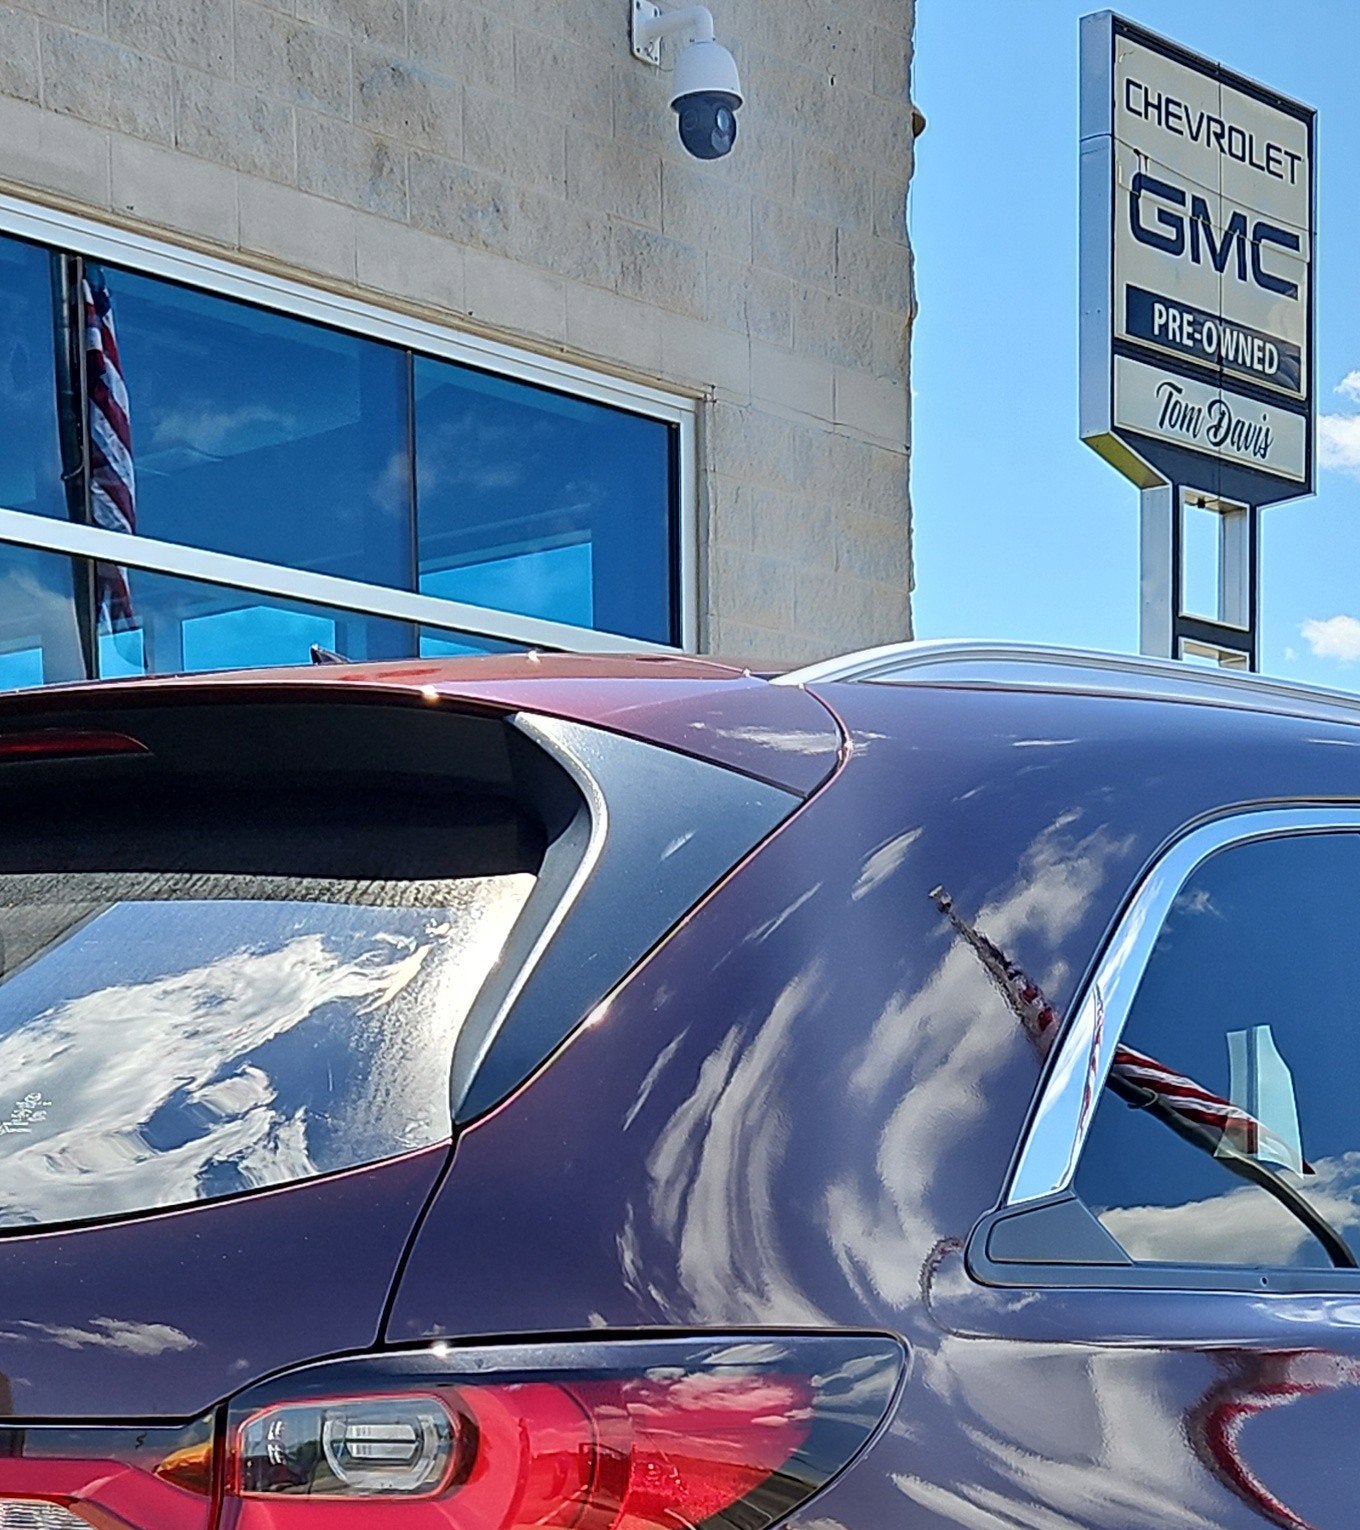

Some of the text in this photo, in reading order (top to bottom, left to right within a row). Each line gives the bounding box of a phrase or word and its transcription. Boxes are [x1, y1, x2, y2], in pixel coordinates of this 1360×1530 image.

[1125, 77, 1303, 186] CHEVROLET
[1129, 171, 1301, 302] GMC
[1153, 302, 1279, 376] PRE-OWNED
[1155, 381, 1274, 460] Tom Davis
